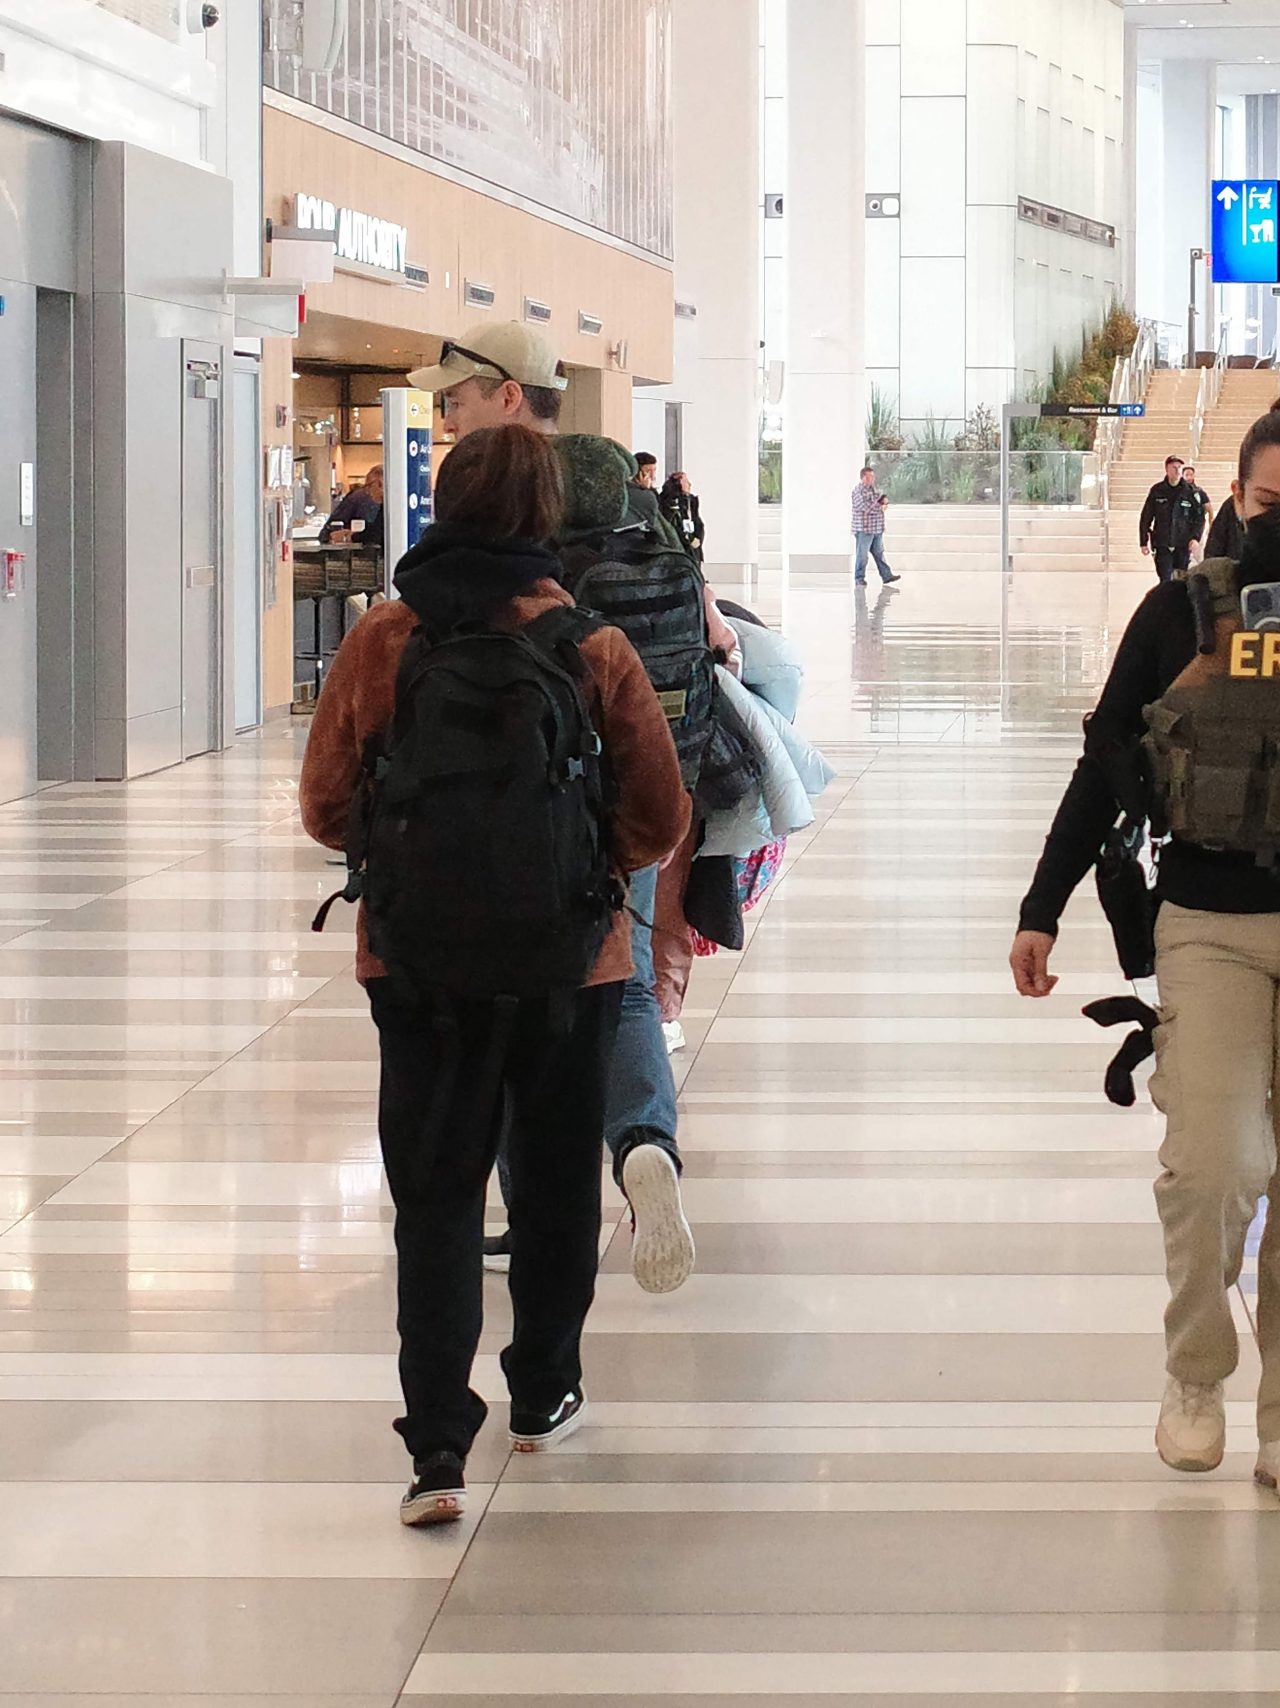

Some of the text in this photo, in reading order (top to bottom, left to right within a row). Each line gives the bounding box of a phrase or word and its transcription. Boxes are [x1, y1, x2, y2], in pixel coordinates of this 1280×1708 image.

[338, 207, 408, 273] AUTHORITY
[1068, 406, 1101, 414] Restaurant
[1107, 406, 1118, 414] Bar
